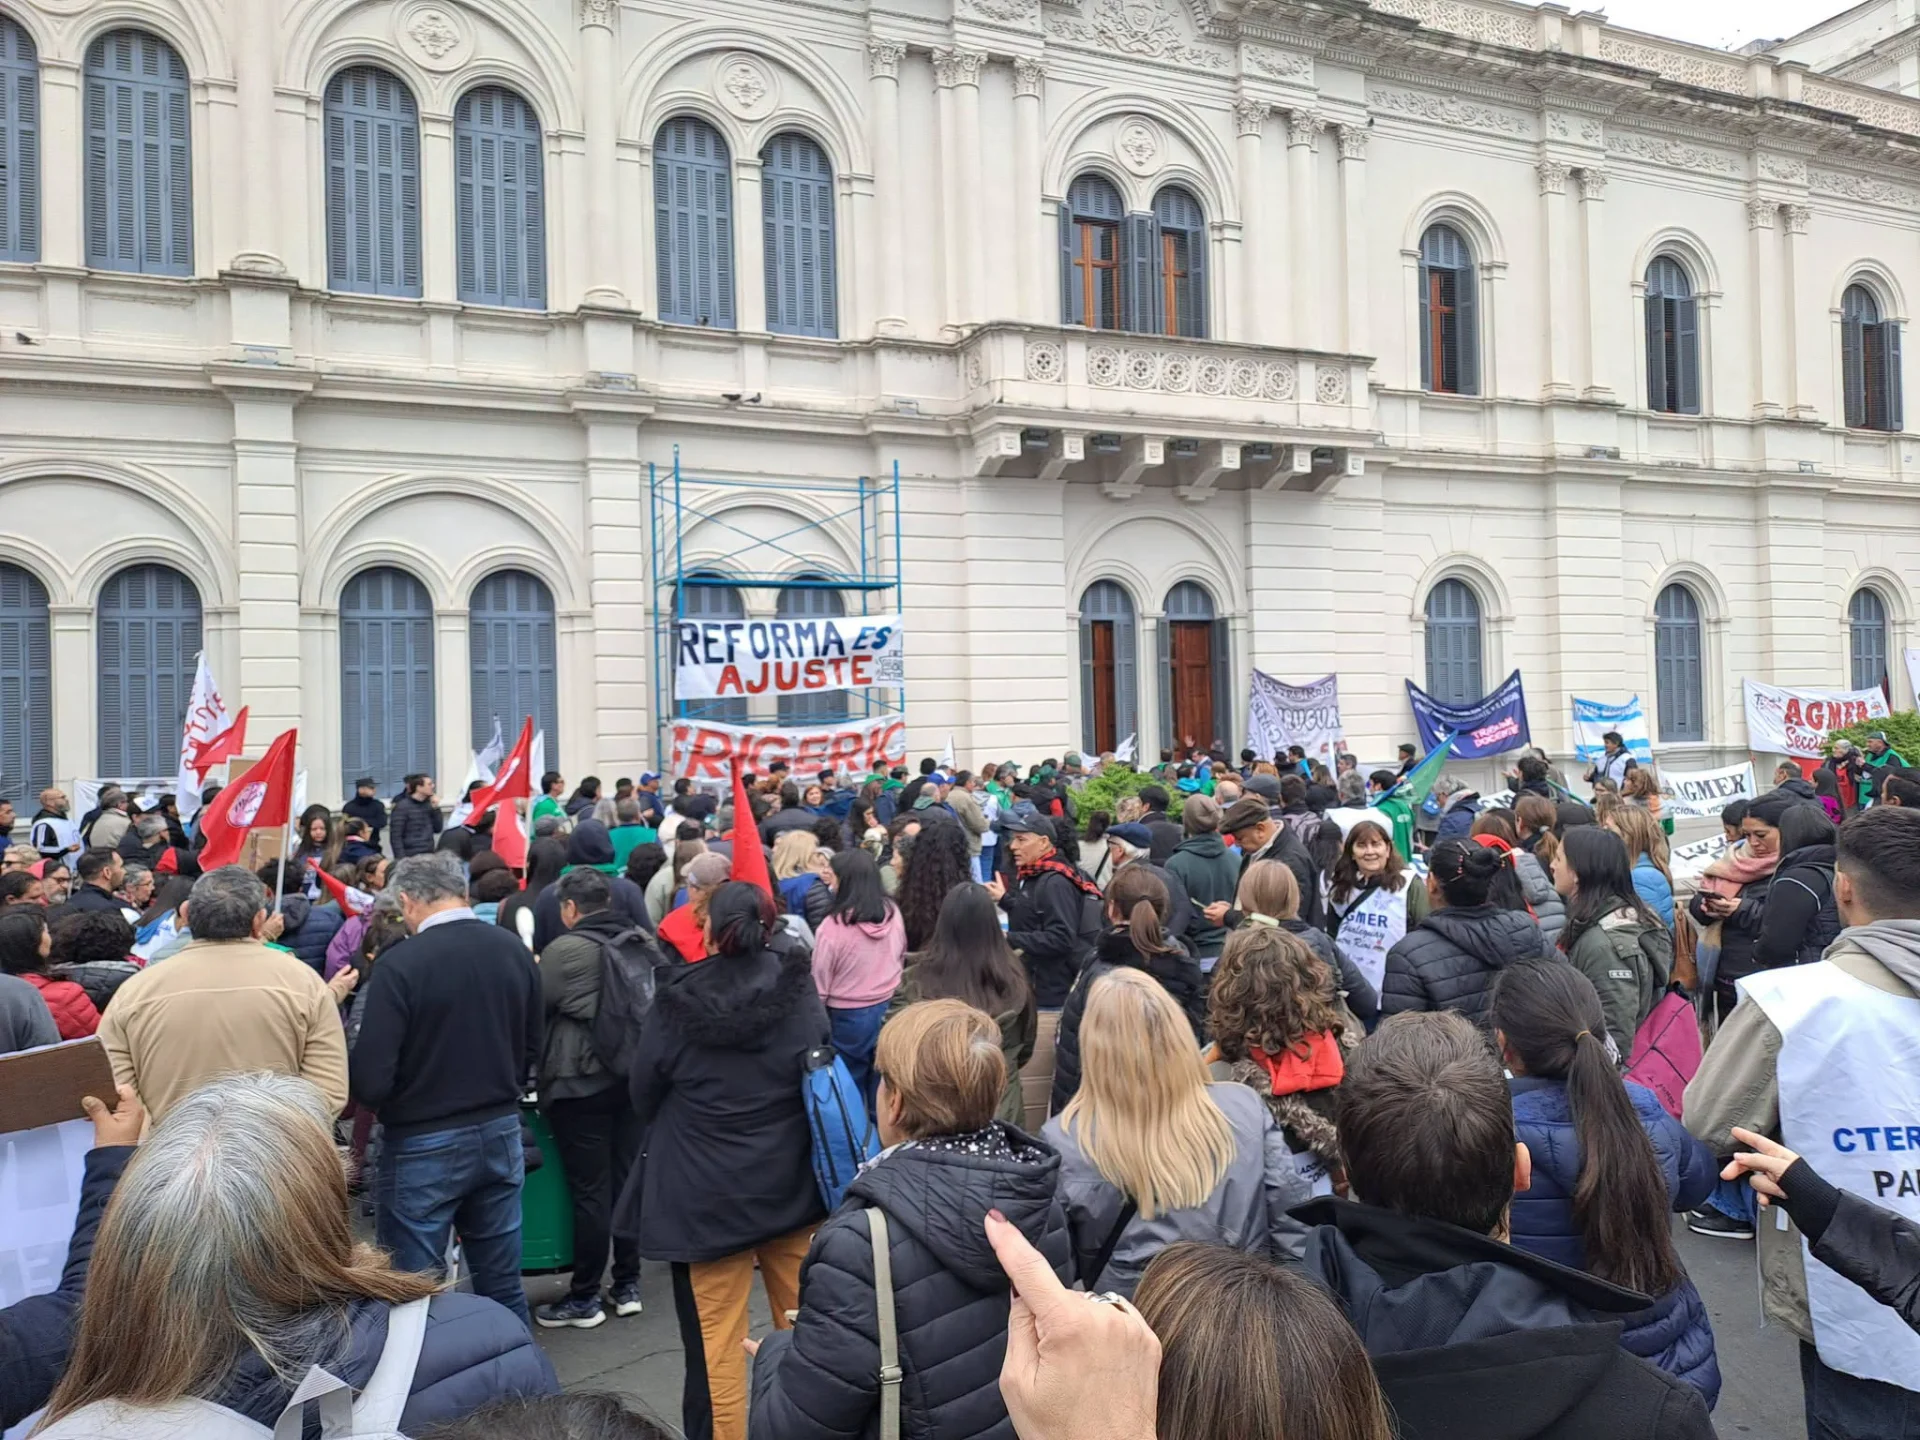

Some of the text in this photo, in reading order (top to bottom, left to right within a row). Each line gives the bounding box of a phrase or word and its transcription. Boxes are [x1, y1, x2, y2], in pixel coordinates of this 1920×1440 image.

[679, 621, 845, 666] REFORMA
[852, 625, 892, 650] ES
[716, 655, 873, 695] AJUSTE
[1784, 697, 1870, 731] AGMER
[1675, 773, 1746, 802] AGMER
[1668, 804, 1726, 817] CCIONAL VICT
[1346, 912, 1388, 928] GMER
[1873, 1169, 1920, 1197] PA
